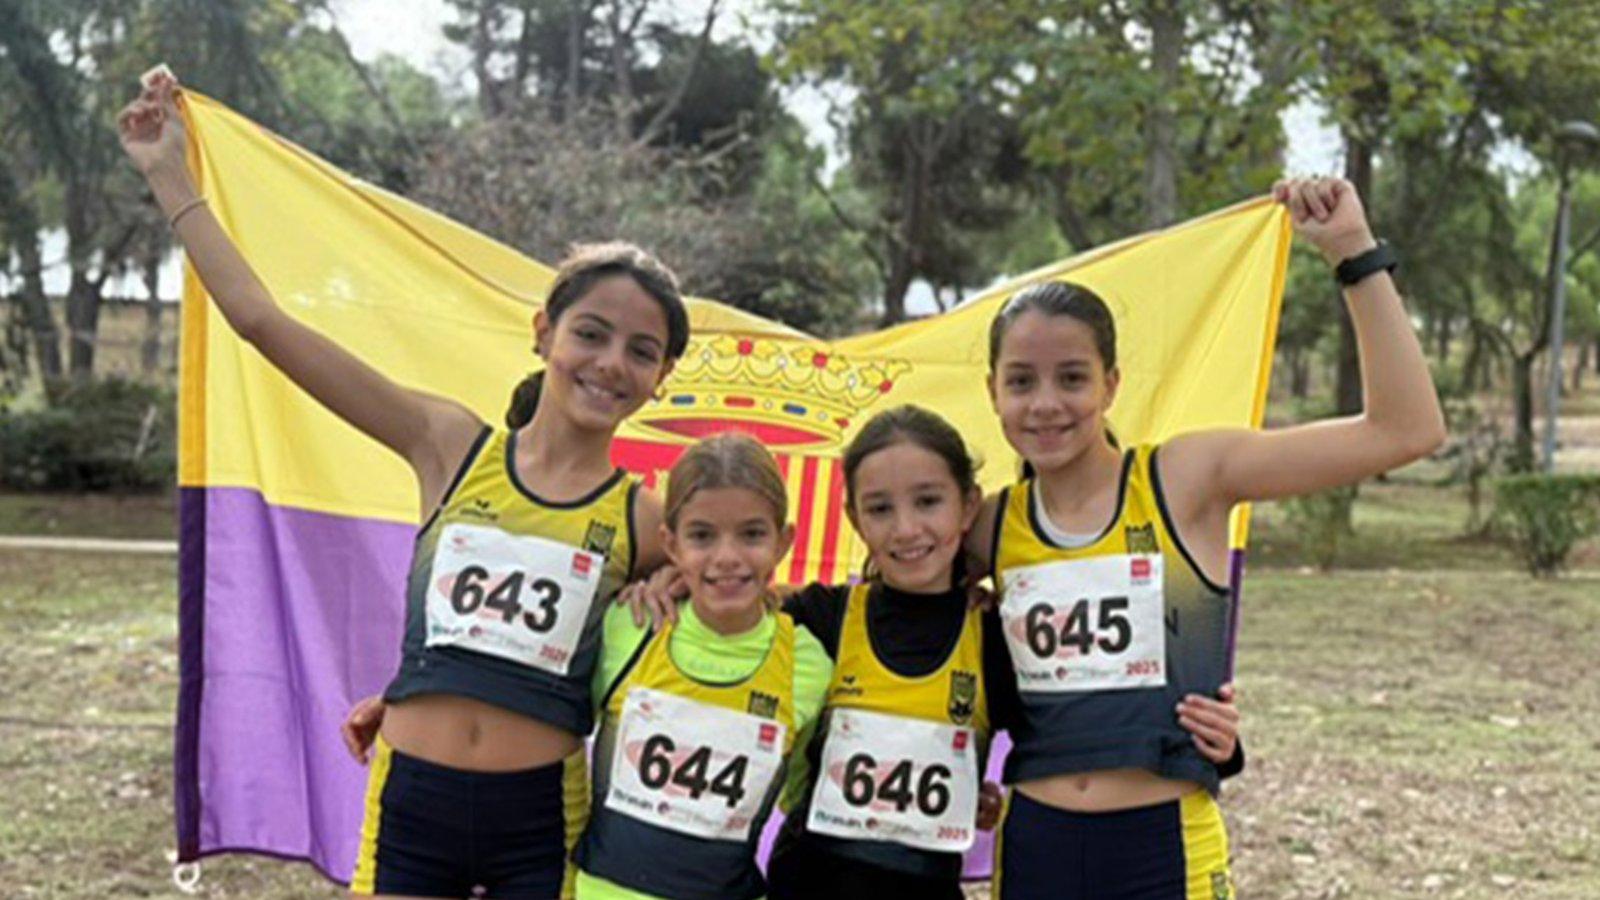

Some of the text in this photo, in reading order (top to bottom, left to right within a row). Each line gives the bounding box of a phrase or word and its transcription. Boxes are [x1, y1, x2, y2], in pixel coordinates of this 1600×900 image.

[451, 565, 562, 633] 643
[1025, 596, 1132, 659] 645
[639, 734, 749, 808] 644
[843, 752, 952, 817] 646
